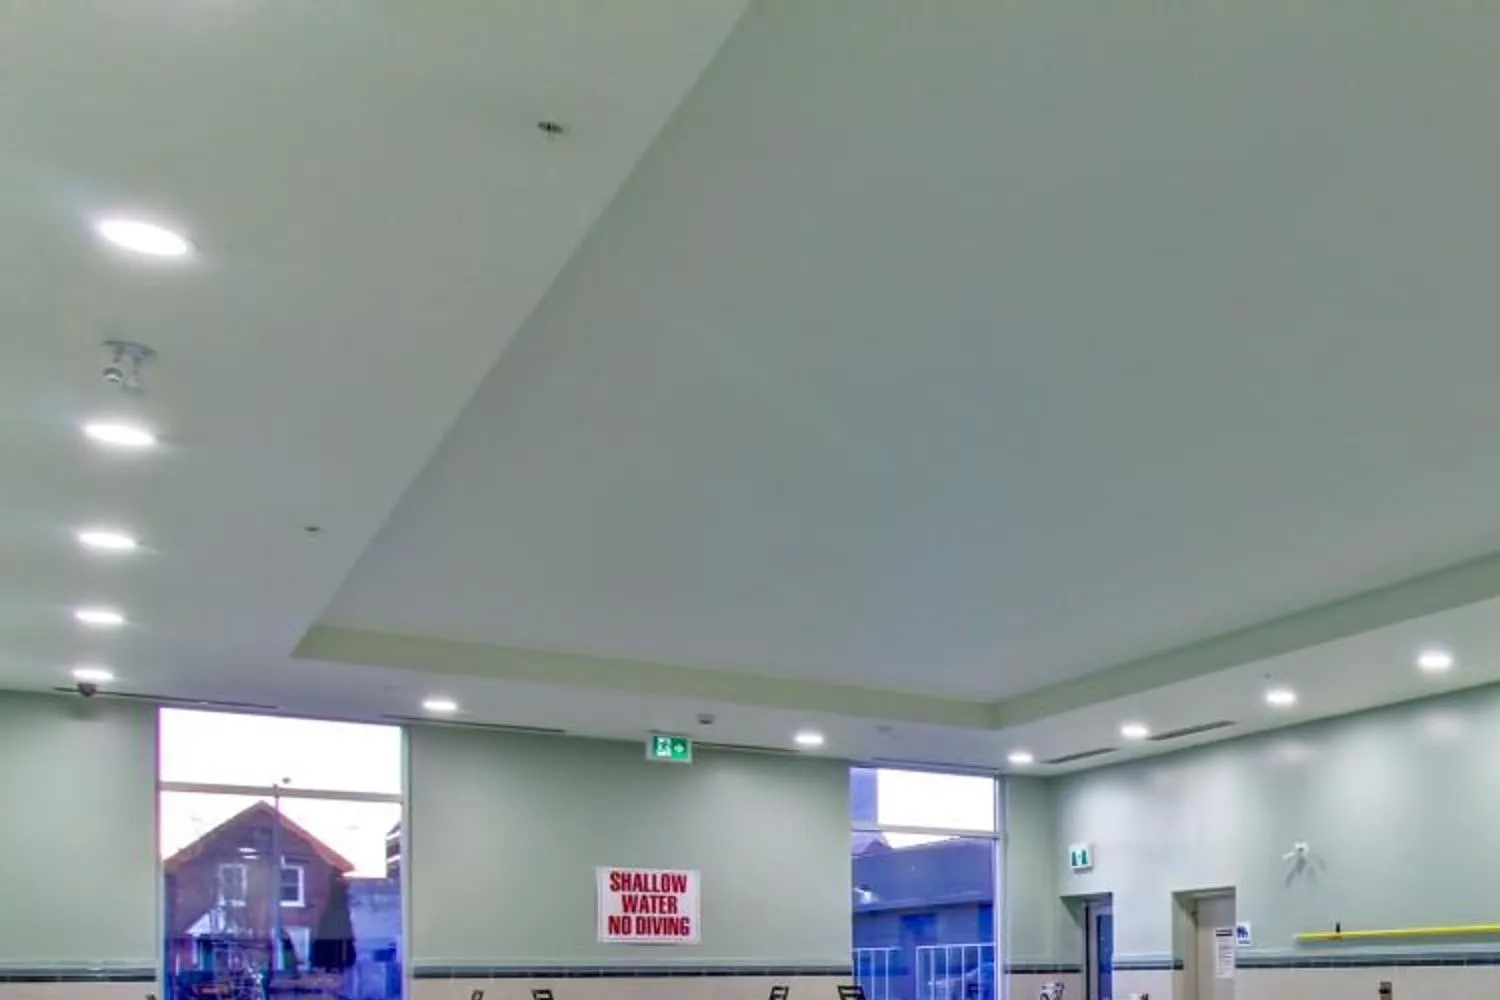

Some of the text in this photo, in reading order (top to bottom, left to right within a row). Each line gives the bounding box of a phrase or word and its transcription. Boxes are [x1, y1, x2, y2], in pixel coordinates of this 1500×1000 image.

[609, 871, 687, 893] SHALLOW
[622, 894, 678, 914] WATER
[608, 915, 690, 936] NO DIVING
